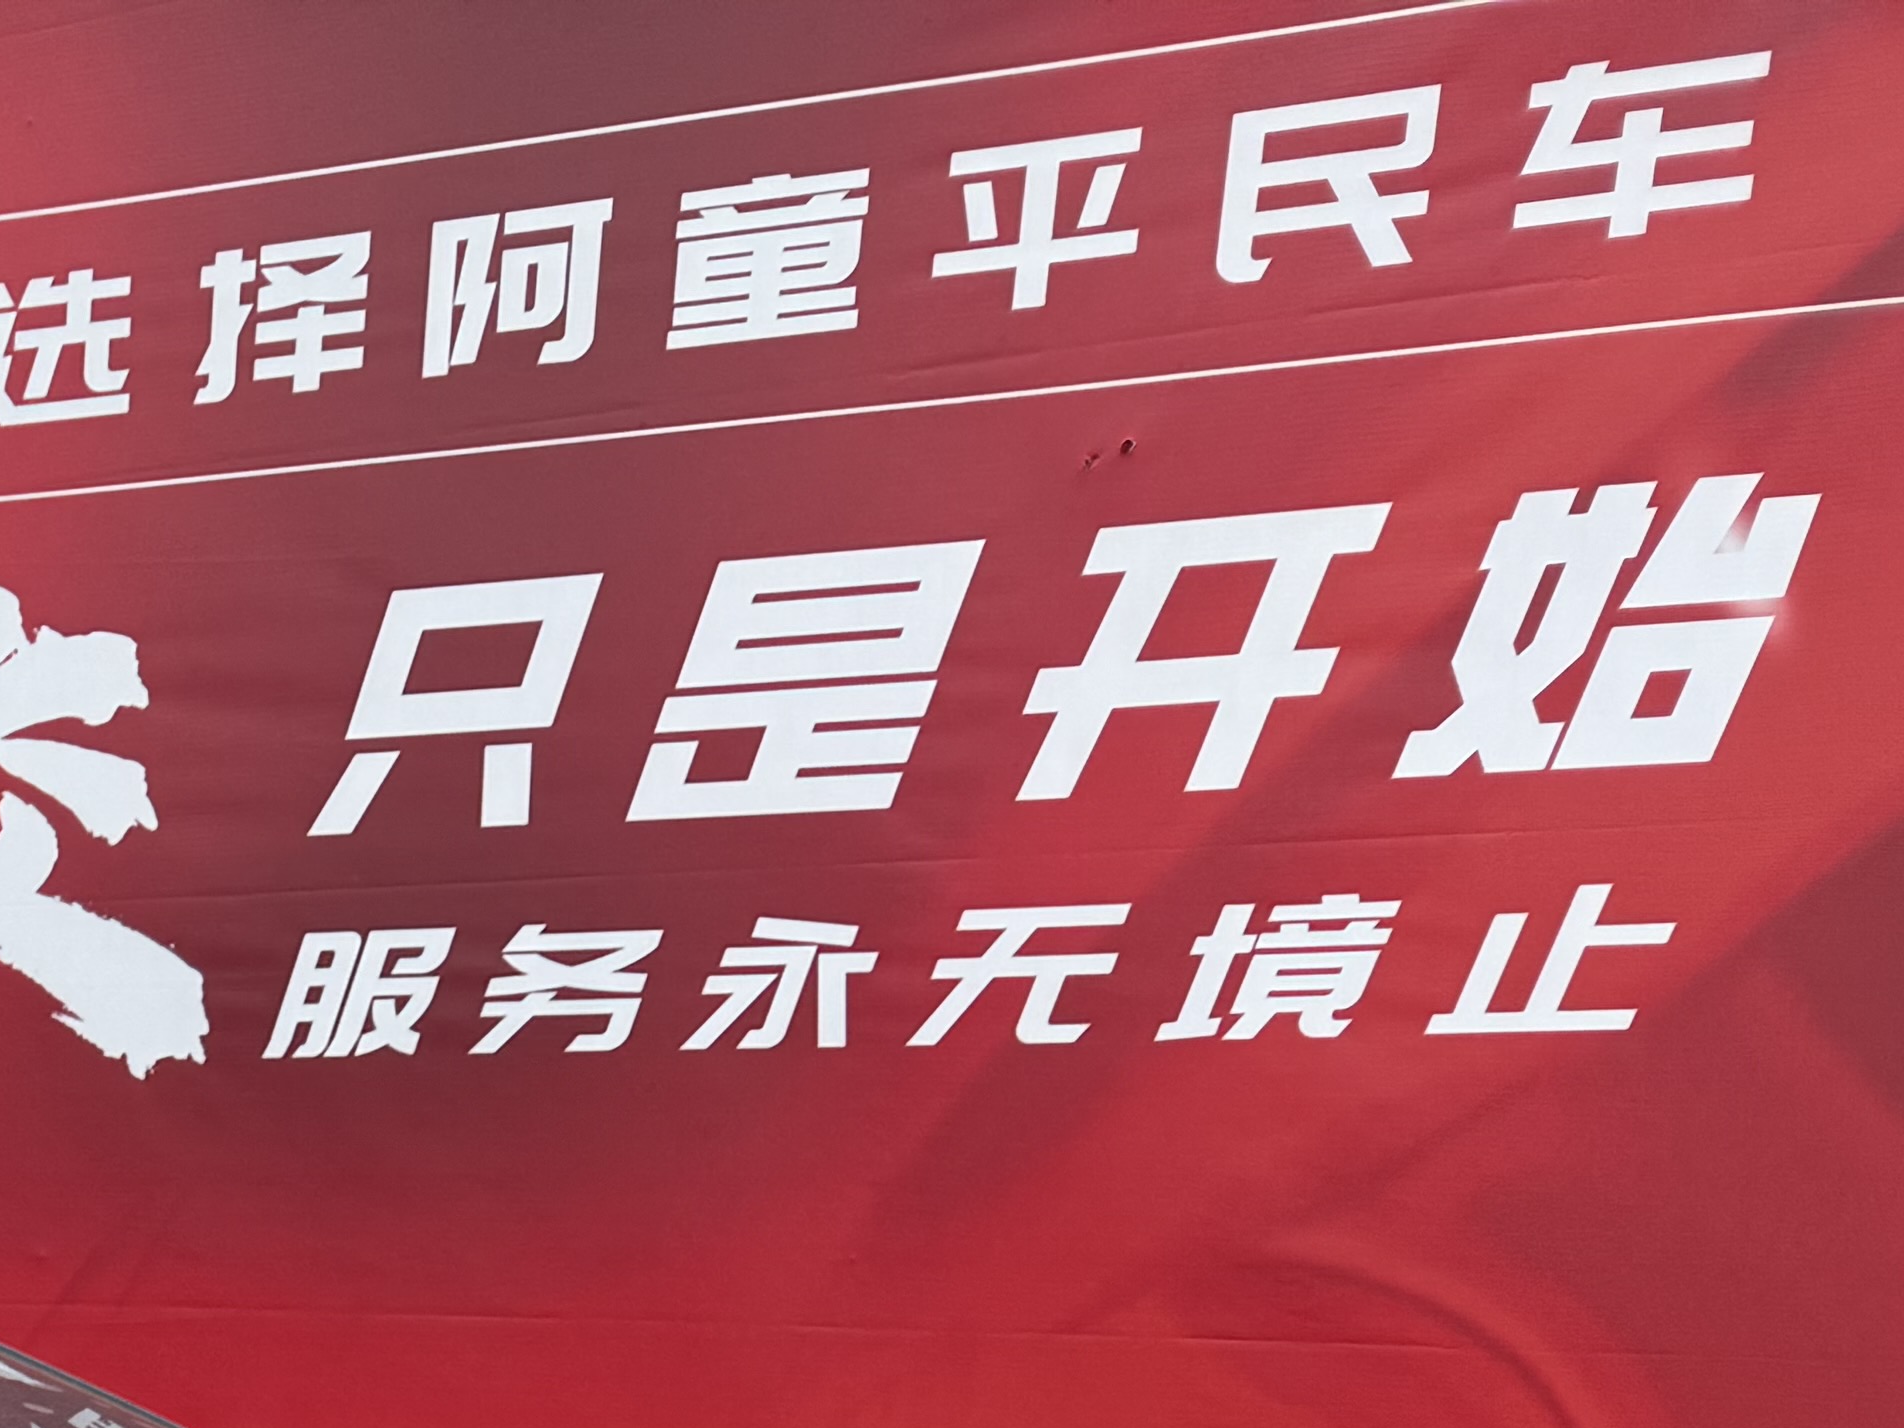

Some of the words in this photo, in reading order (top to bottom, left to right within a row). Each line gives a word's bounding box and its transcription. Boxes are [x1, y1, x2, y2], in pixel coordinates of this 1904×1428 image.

[306, 471, 1824, 837] 只是开始
[261, 883, 1678, 1059] 服务永无境止
